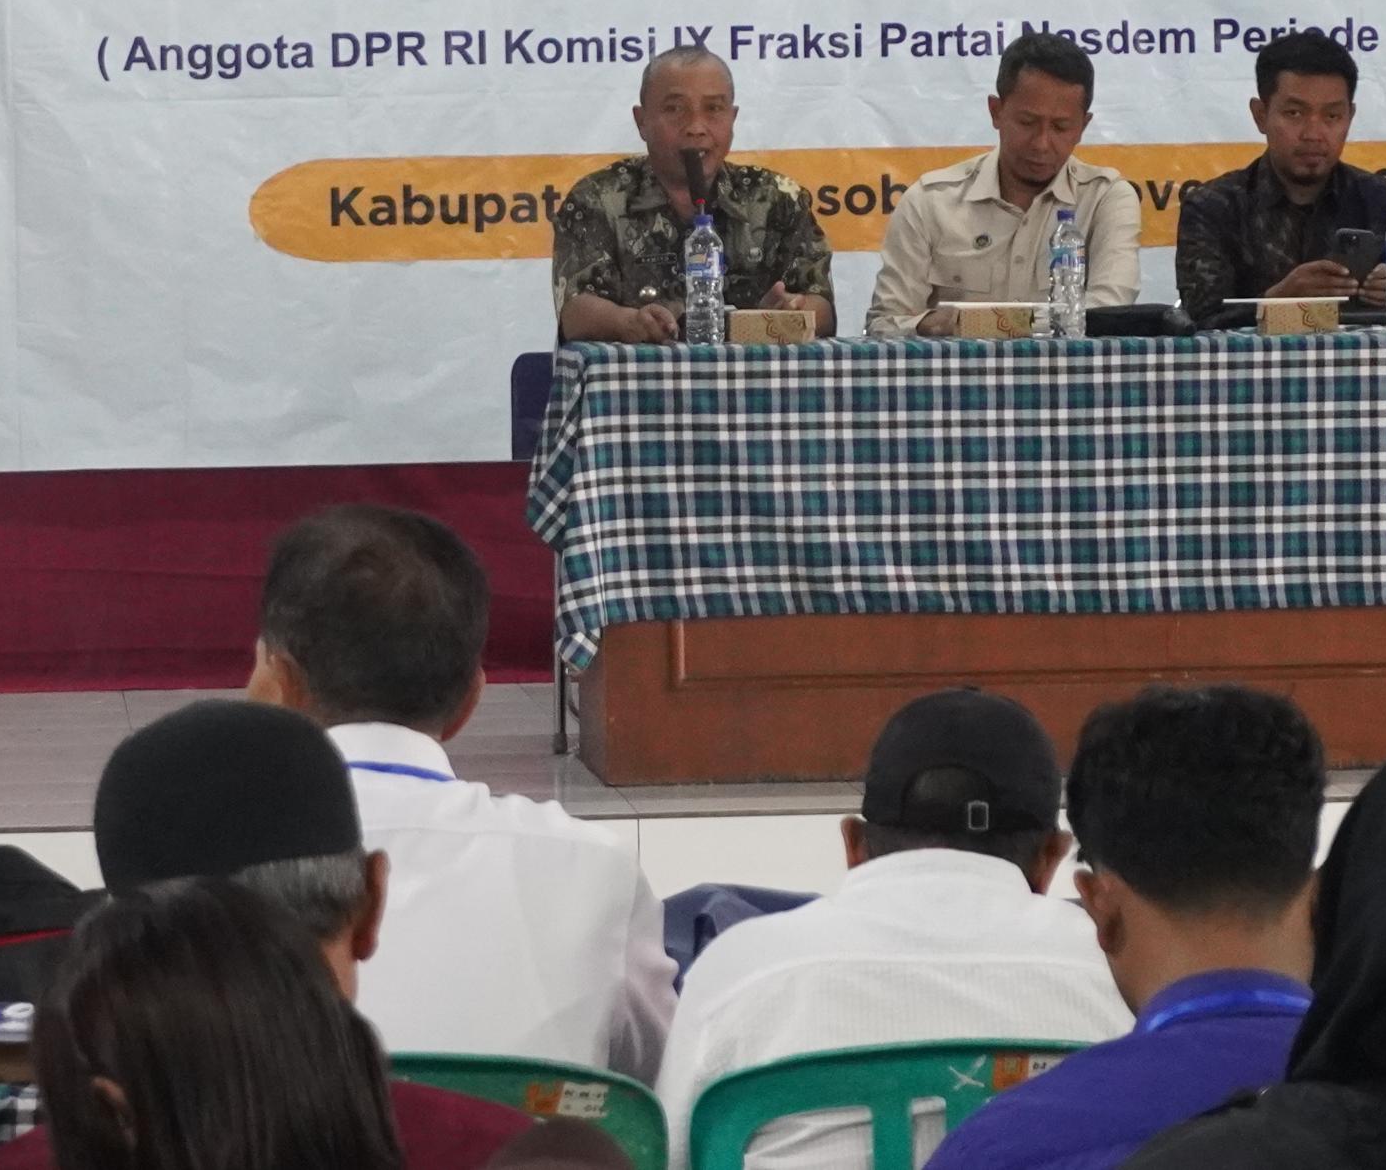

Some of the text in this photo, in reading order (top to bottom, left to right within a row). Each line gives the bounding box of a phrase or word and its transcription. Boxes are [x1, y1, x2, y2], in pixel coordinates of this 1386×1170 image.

[123, 35, 314, 80] Anggota
[331, 31, 428, 68] DPR
[444, 29, 487, 66] RI
[504, 27, 656, 66] Komisi
[730, 22, 862, 61] Fraksi
[880, 21, 1004, 59] Partai
[330, 184, 561, 233] Kabupat
